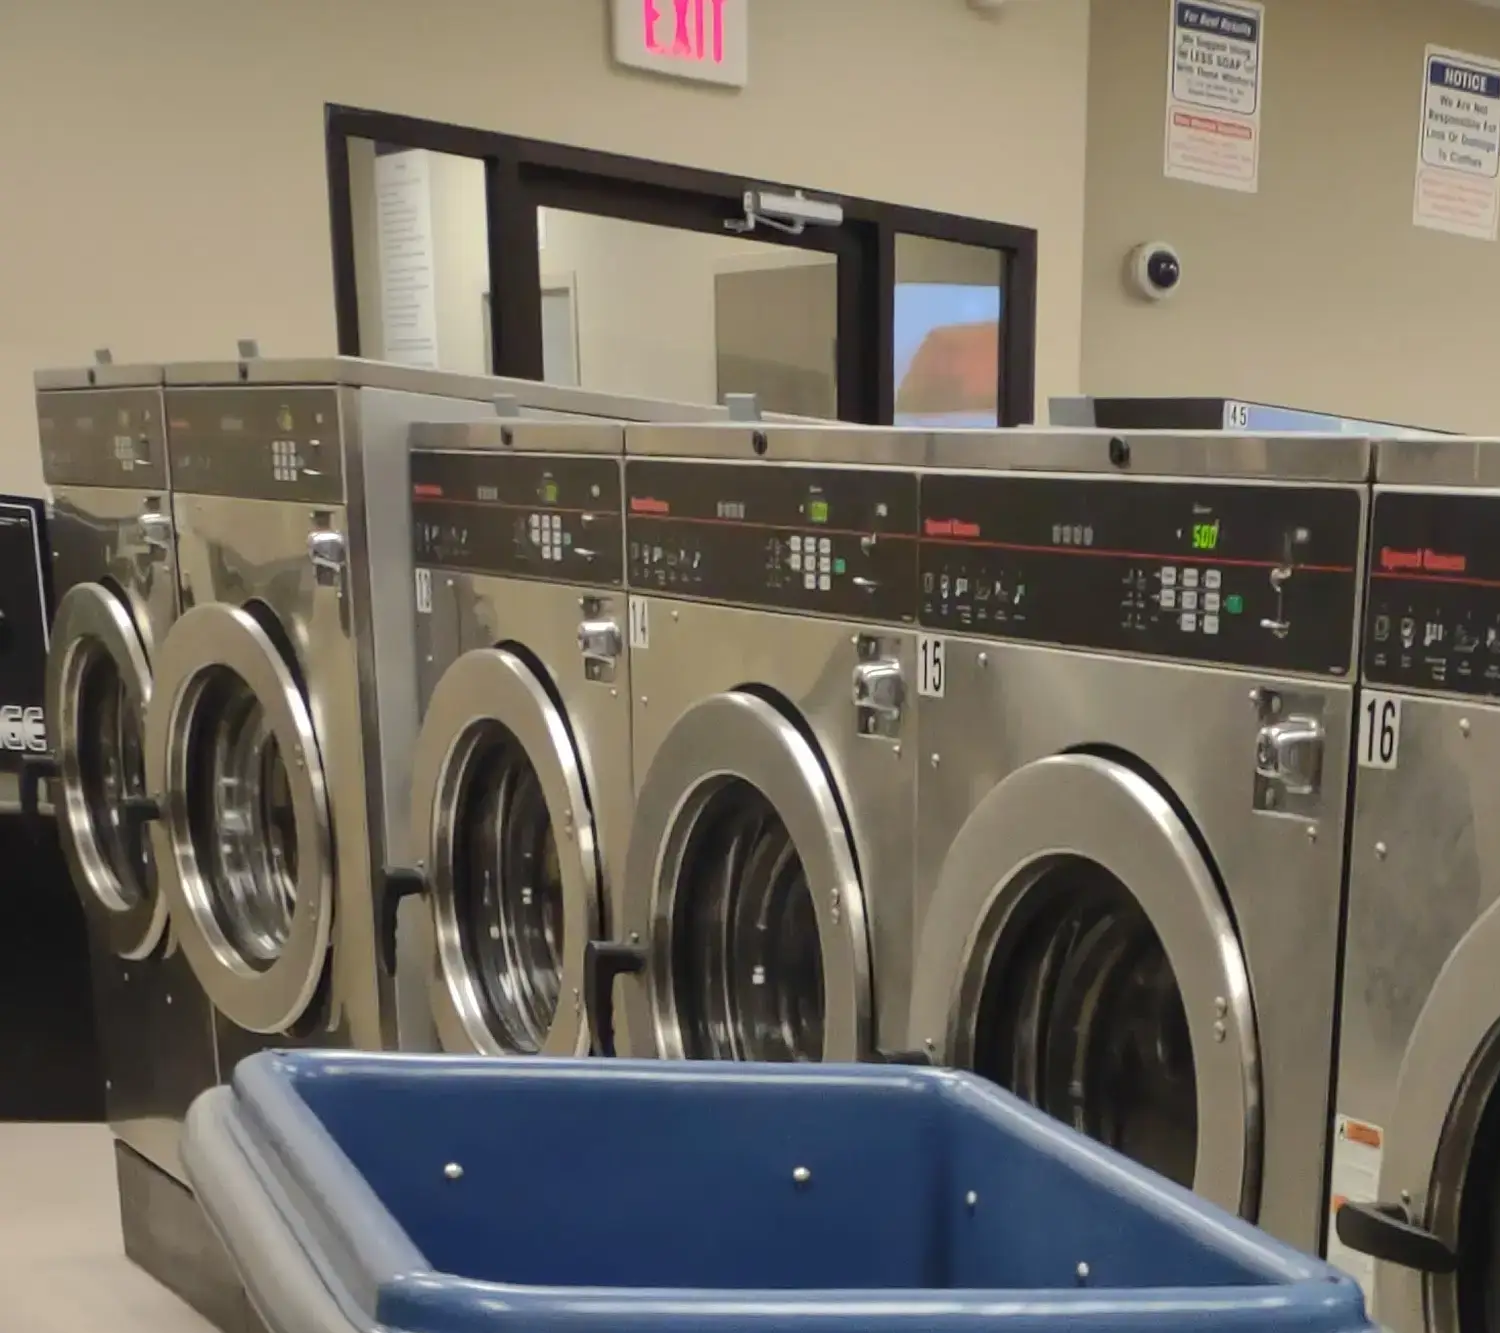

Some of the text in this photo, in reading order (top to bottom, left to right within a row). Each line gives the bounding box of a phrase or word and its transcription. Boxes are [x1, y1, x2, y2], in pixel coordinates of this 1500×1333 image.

[643, 0, 727, 64] EXIT
[1444, 67, 1488, 92] NOTICE
[1440, 95, 1489, 116] We Are Not
[1428, 108, 1498, 134] Responsible For
[1448, 131, 1458, 143] Or
[1461, 133, 1496, 154] Damage
[1230, 404, 1247, 426] 45
[922, 639, 942, 692] 15
[0, 704, 48, 752] GE
[1367, 698, 1396, 764] 16
